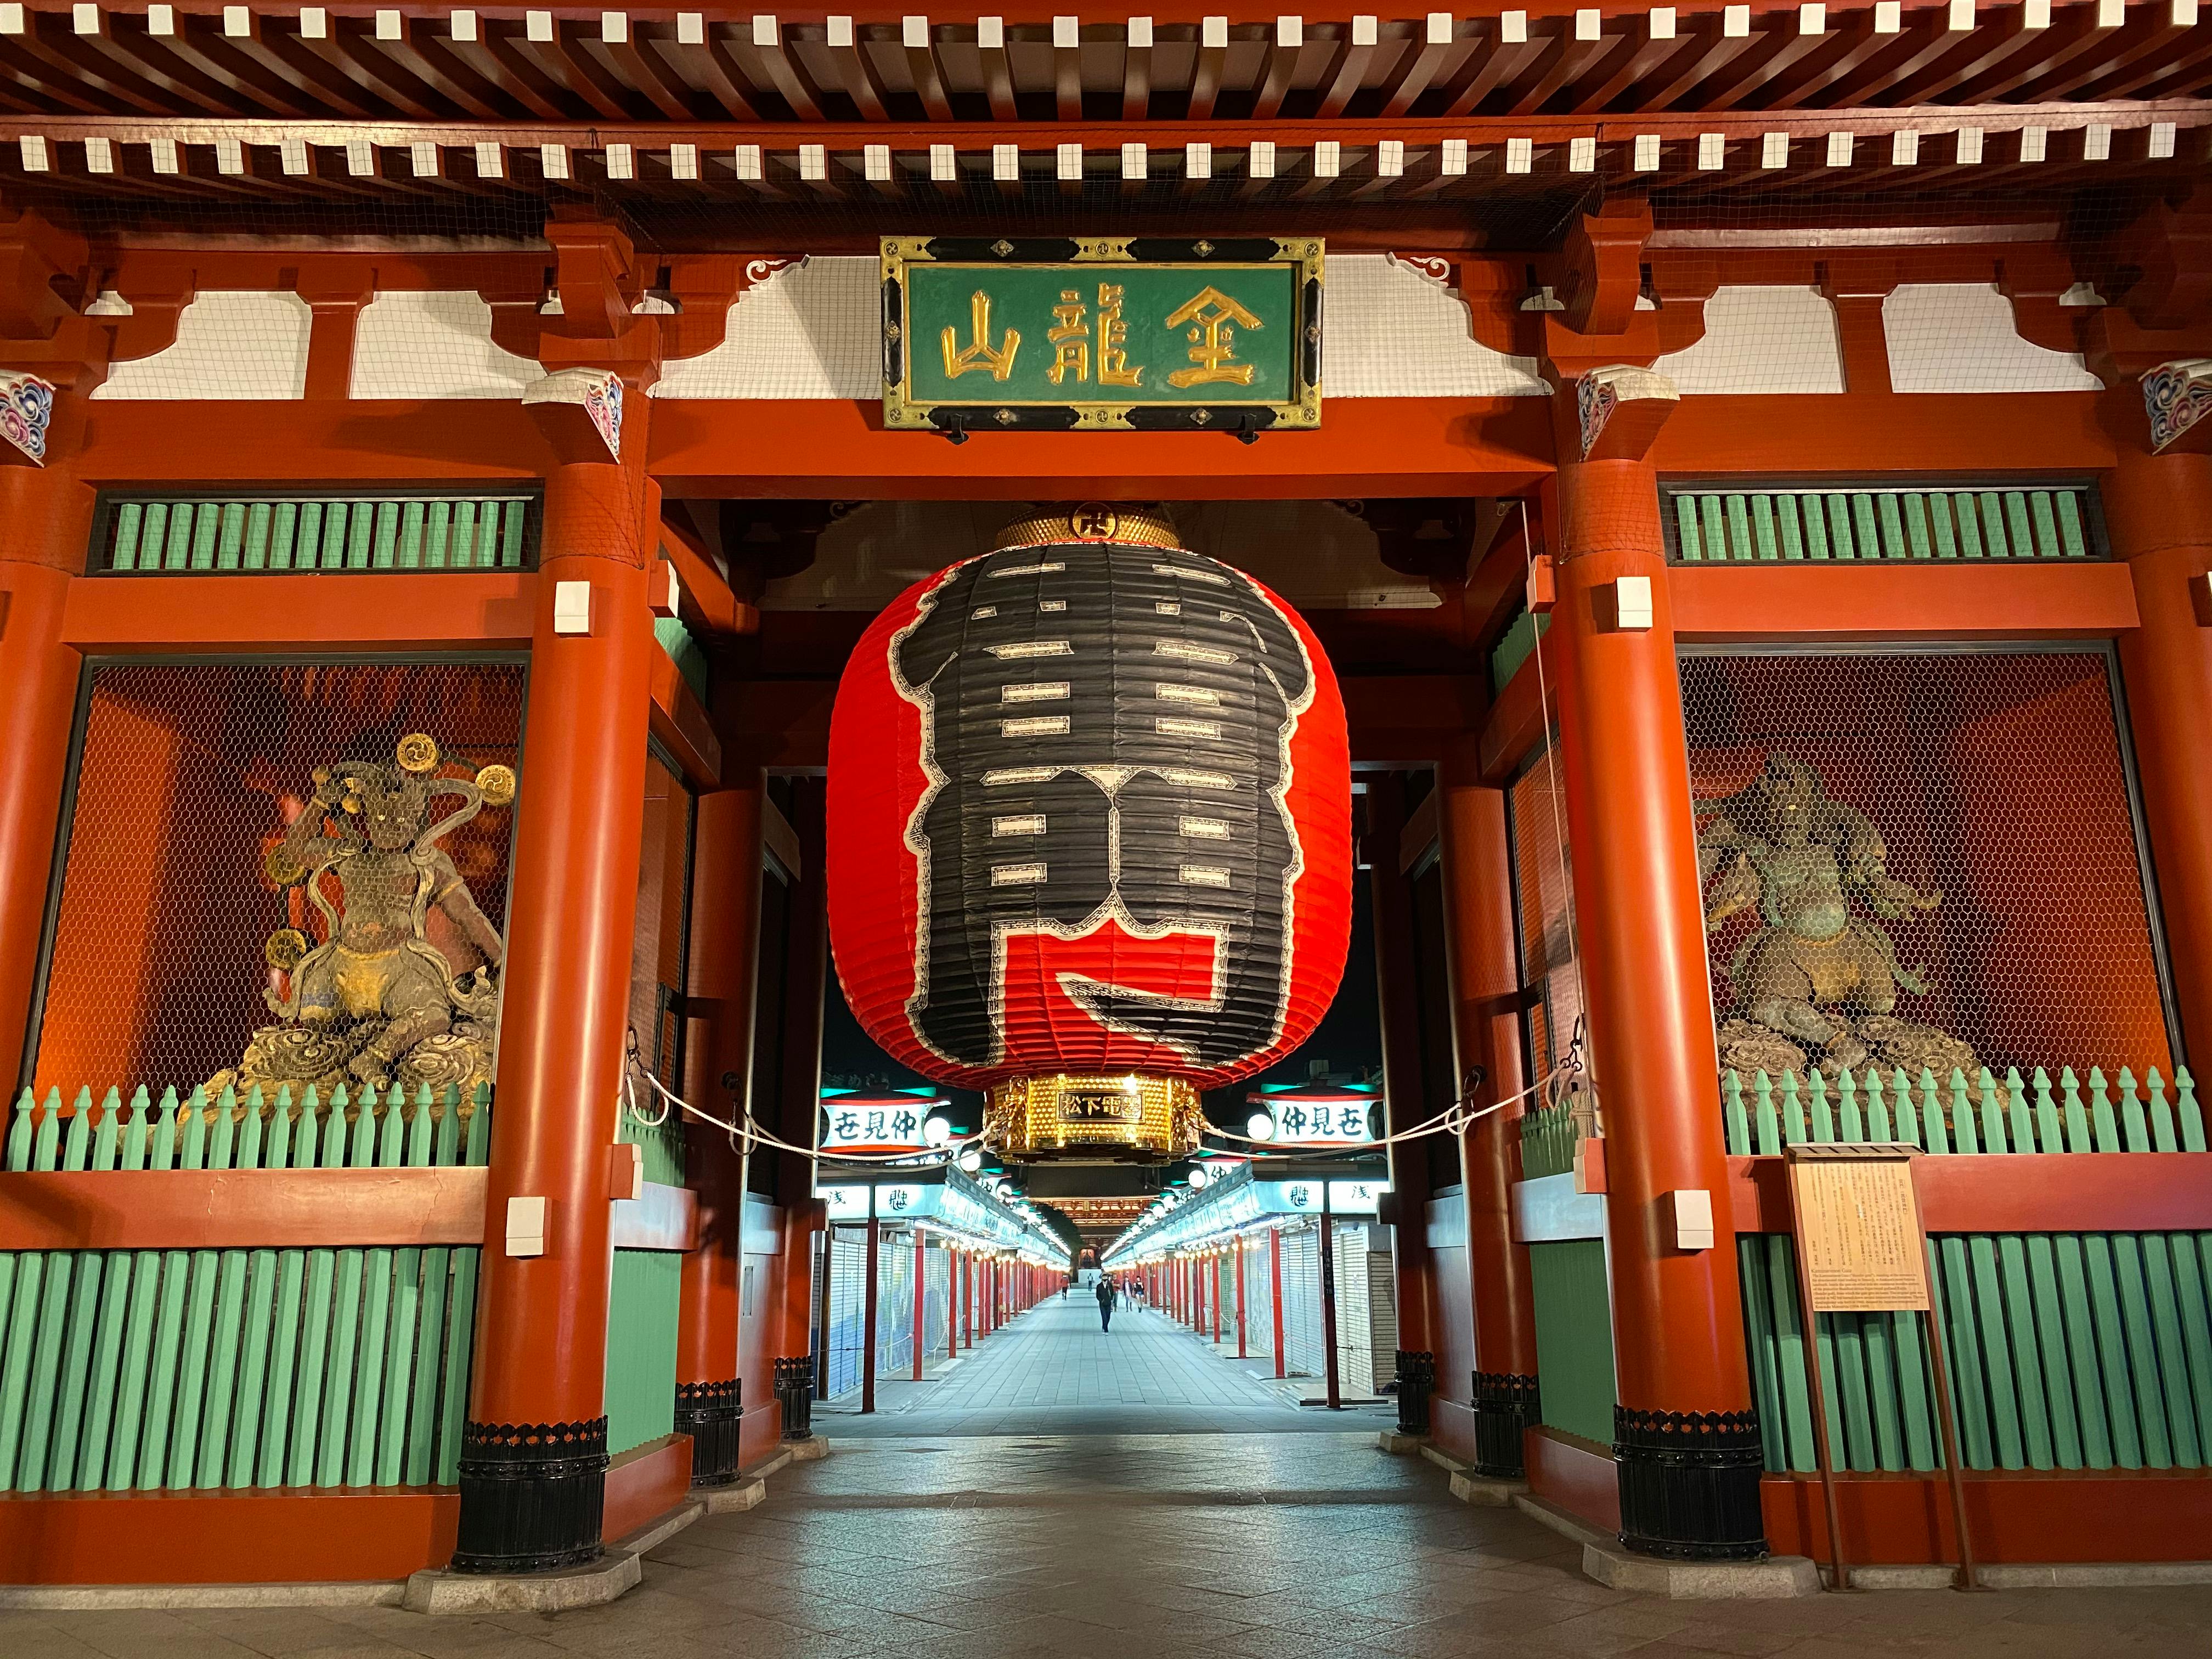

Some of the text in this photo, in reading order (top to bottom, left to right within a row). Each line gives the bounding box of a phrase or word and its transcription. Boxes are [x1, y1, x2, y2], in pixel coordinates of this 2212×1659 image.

[940, 283, 1264, 388] 金龍山
[893, 540, 1314, 1068] 雷門
[1062, 1095, 1141, 1117] 松下電器
[1282, 1106, 1363, 1136] 仲見世
[1351, 1185, 1370, 1199] 浅
